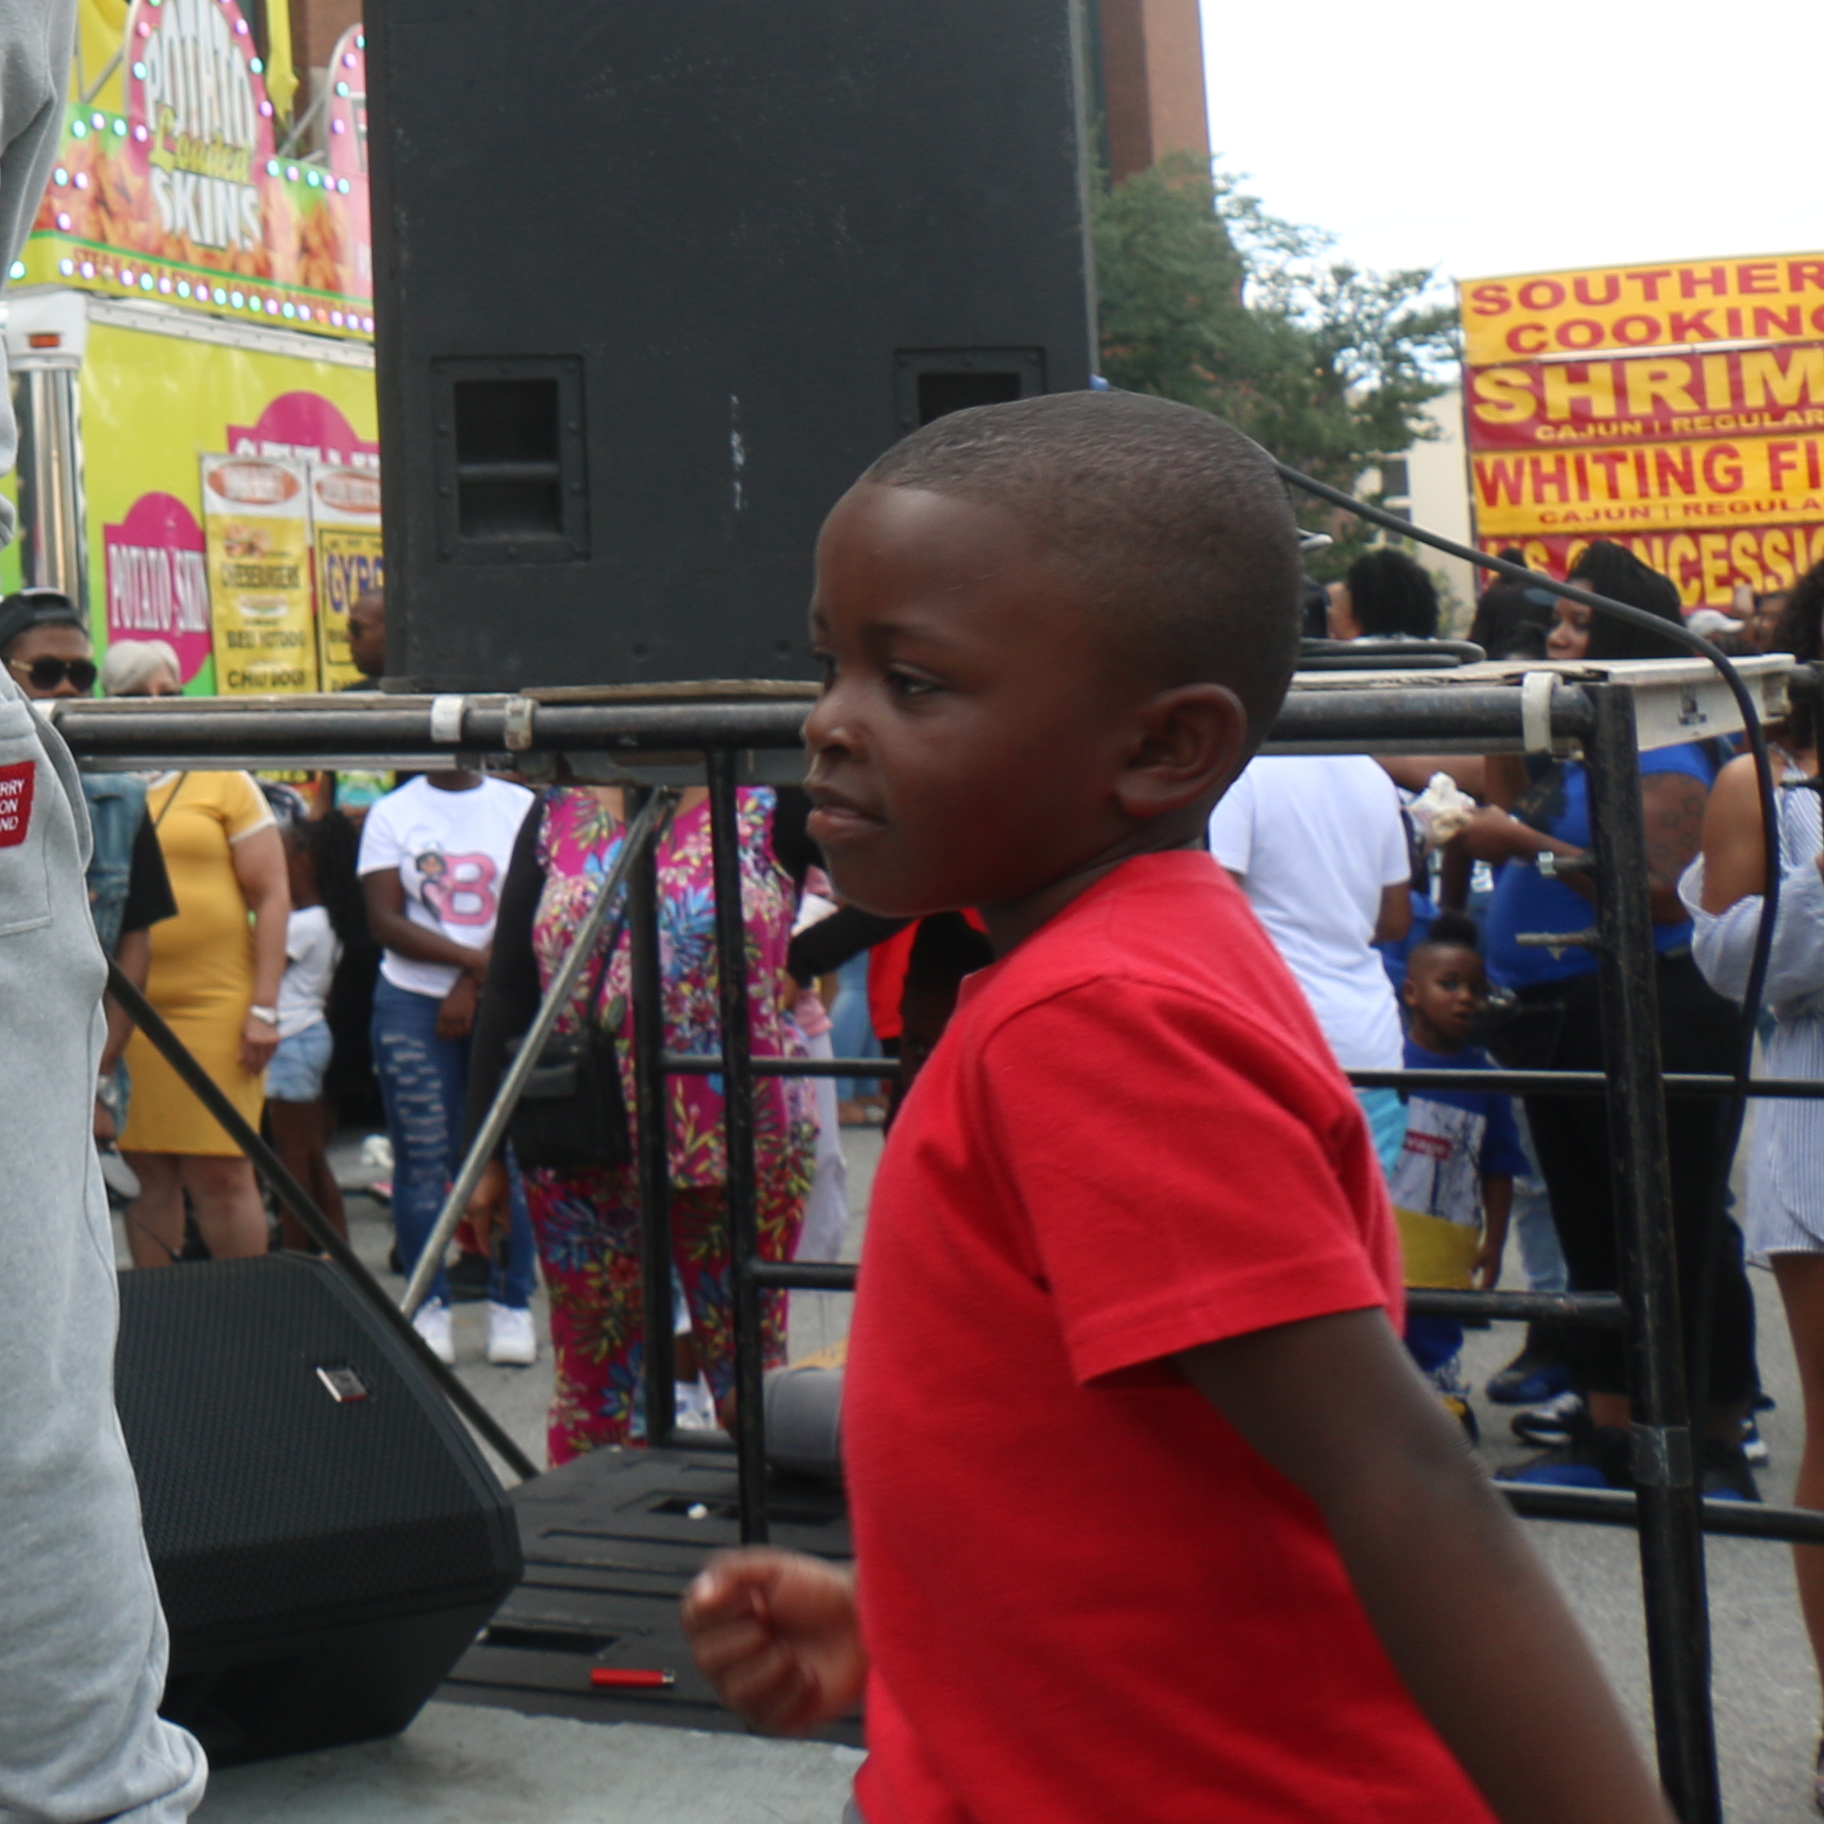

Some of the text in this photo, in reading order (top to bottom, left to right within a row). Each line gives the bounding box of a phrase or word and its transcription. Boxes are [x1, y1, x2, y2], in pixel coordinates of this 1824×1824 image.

[150, 165, 264, 252] SKINS
[1535, 419, 1643, 441] CAJUN
[1473, 442, 1745, 507] WHITING
[1539, 505, 1651, 524] CAJUN
[109, 543, 172, 632] POTATO
